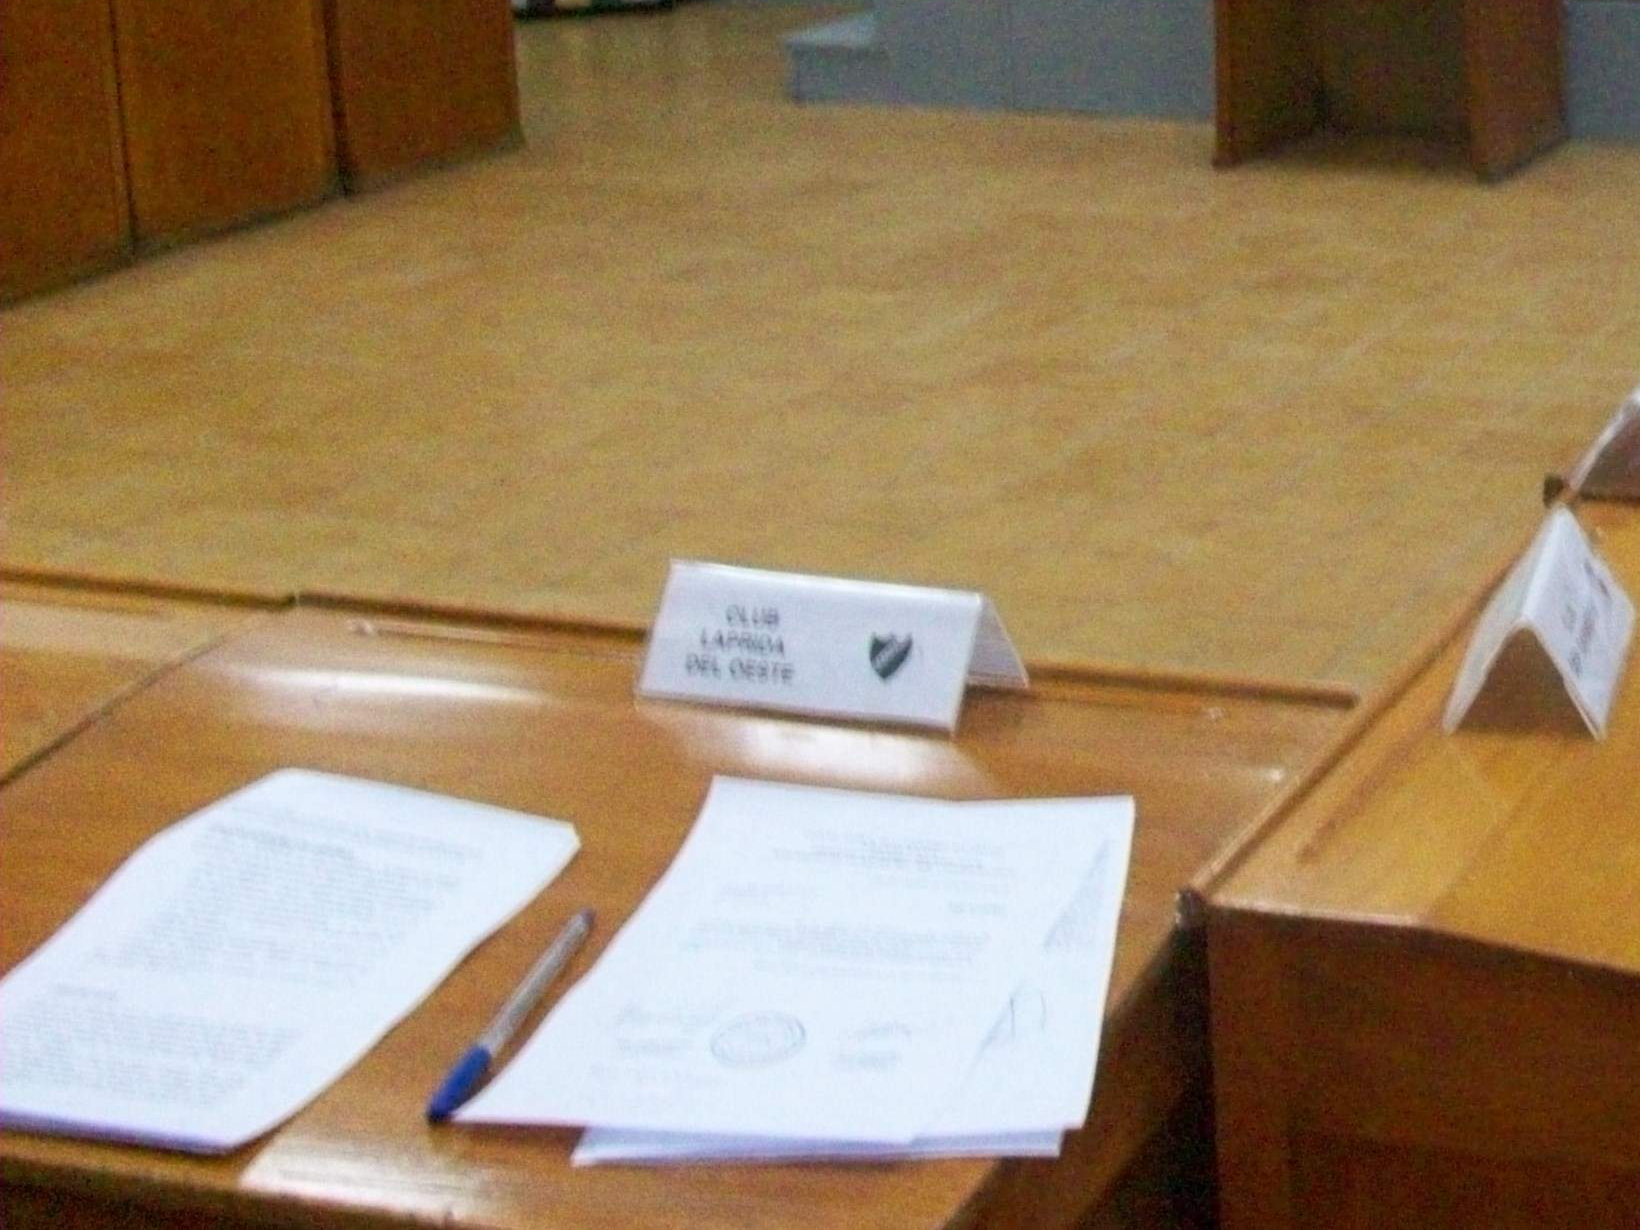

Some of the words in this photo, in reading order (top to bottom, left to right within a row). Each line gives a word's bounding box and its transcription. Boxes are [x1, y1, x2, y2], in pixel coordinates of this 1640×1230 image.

[724, 603, 780, 631] CLUB
[685, 652, 722, 681] DEL
[729, 656, 795, 685] OESTE
